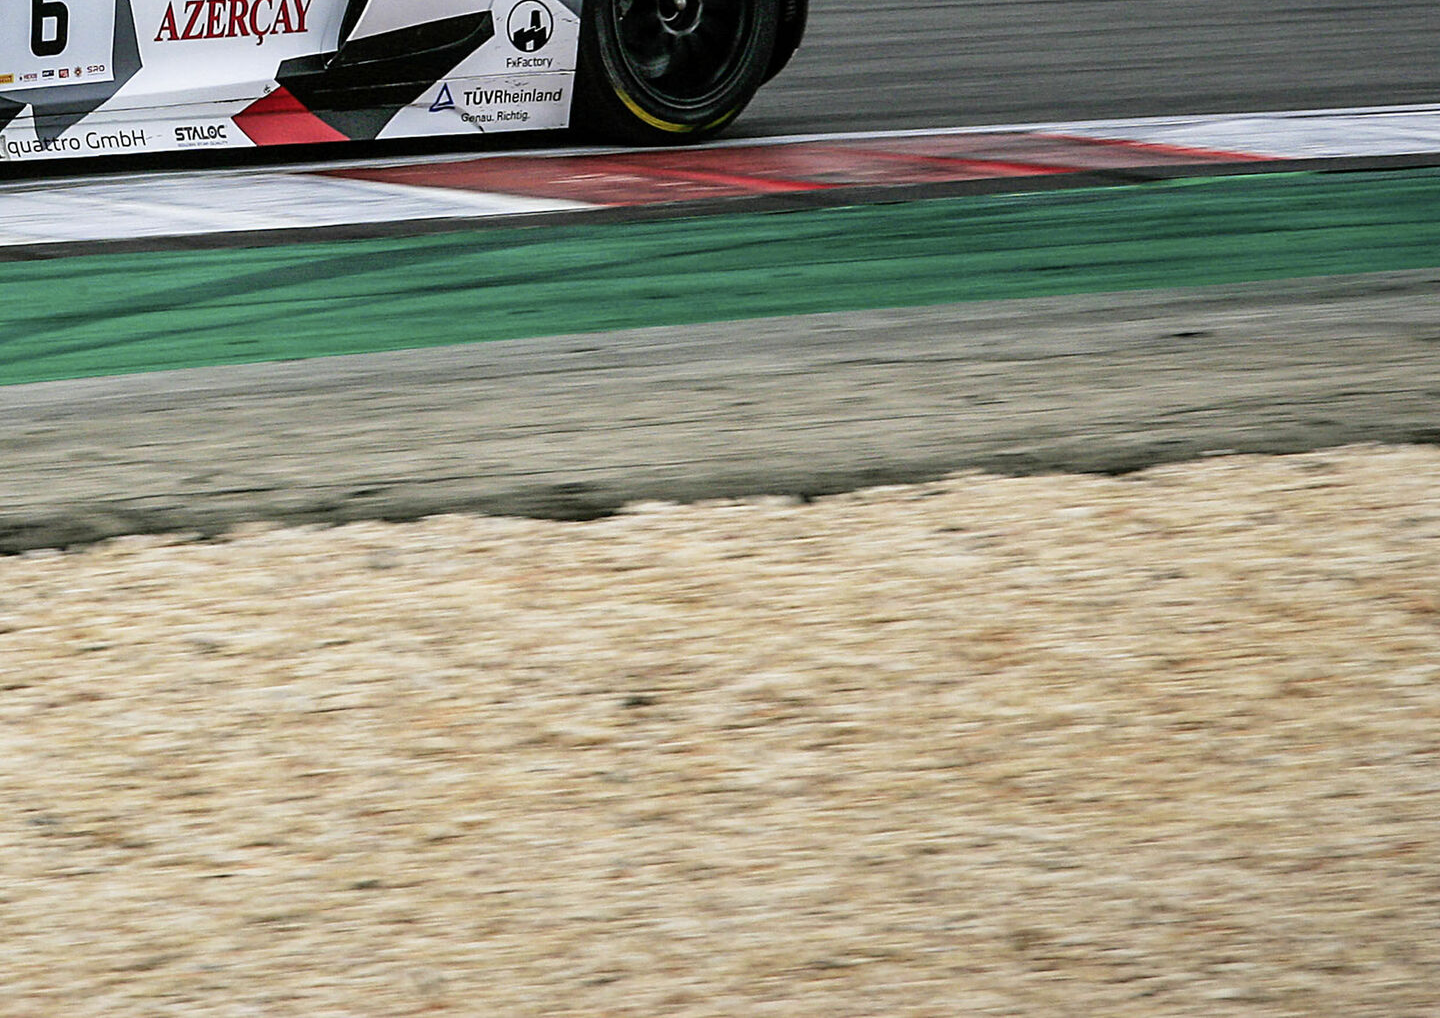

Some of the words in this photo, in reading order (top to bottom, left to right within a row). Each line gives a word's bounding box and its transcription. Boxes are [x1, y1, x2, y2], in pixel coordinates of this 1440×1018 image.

[506, 57, 553, 68] FxFactory
[174, 124, 227, 141] STALOC
[7, 135, 80, 155] quattro
[85, 130, 147, 149] GmbH
